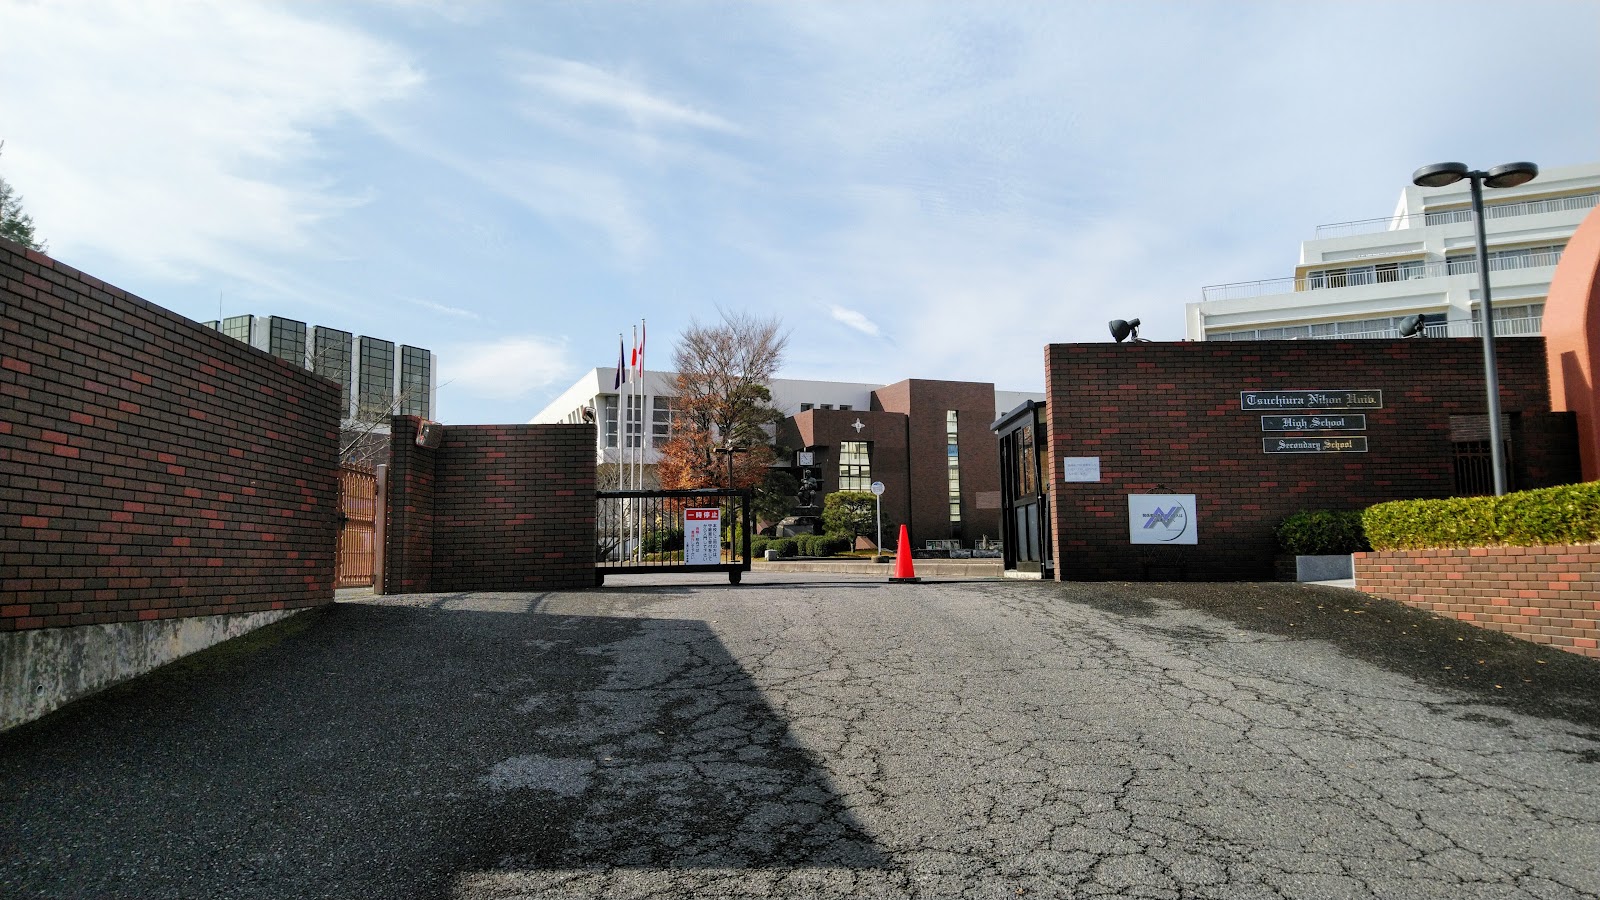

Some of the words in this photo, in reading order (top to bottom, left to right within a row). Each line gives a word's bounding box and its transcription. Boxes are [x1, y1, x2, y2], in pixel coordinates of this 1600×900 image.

[1246, 394, 1304, 407] Tsuchiura
[1307, 393, 1342, 407] Nihon
[1346, 393, 1377, 406] Univ.
[1282, 417, 1307, 430] High
[1309, 417, 1345, 429] School
[1277, 439, 1321, 451] Secondary
[1323, 439, 1352, 450] School
